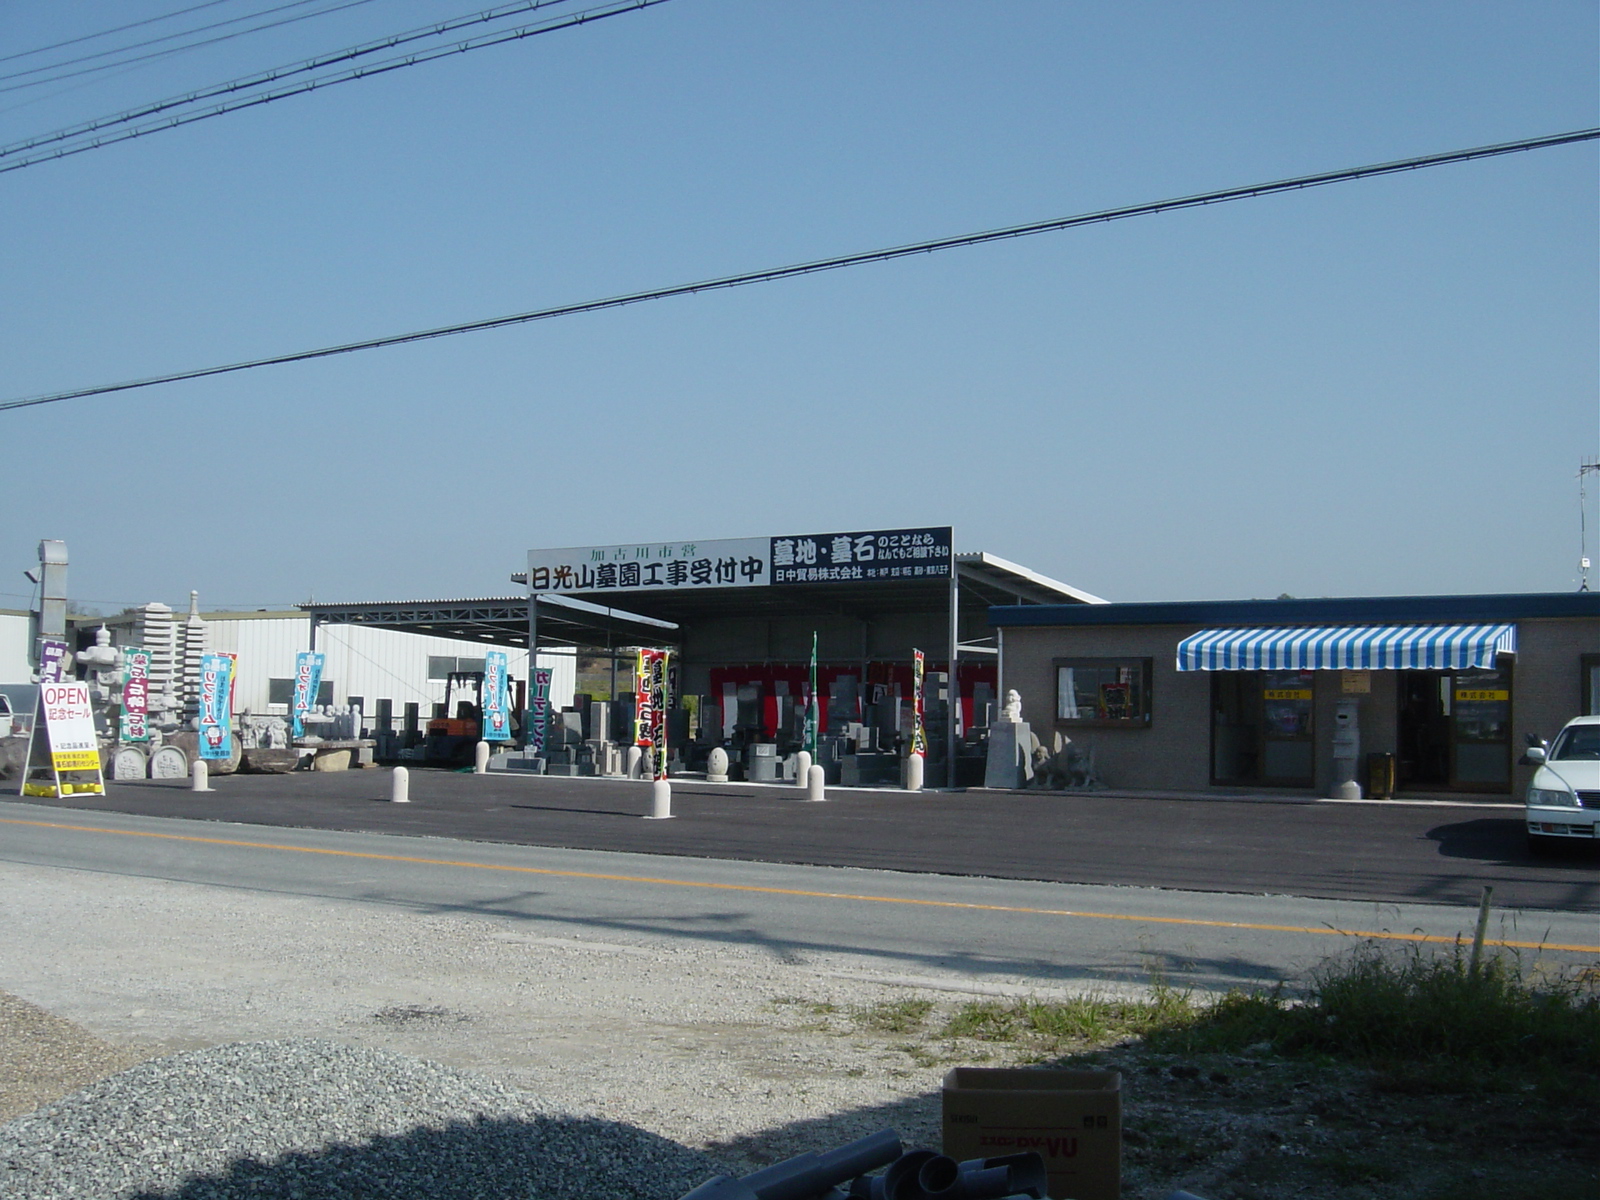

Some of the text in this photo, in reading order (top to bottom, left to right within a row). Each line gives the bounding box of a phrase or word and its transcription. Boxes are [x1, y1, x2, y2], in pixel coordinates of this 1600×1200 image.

[878, 533, 934, 547] のことなら
[590, 544, 697, 561] 加古川市営
[773, 535, 875, 566] 墓地・墓石
[532, 556, 763, 590] 日光山墓園工事受付中
[775, 566, 863, 582] 日中貿易株式会社
[45, 688, 87, 705] OPEN
[48, 708, 91, 720] 記念セール
